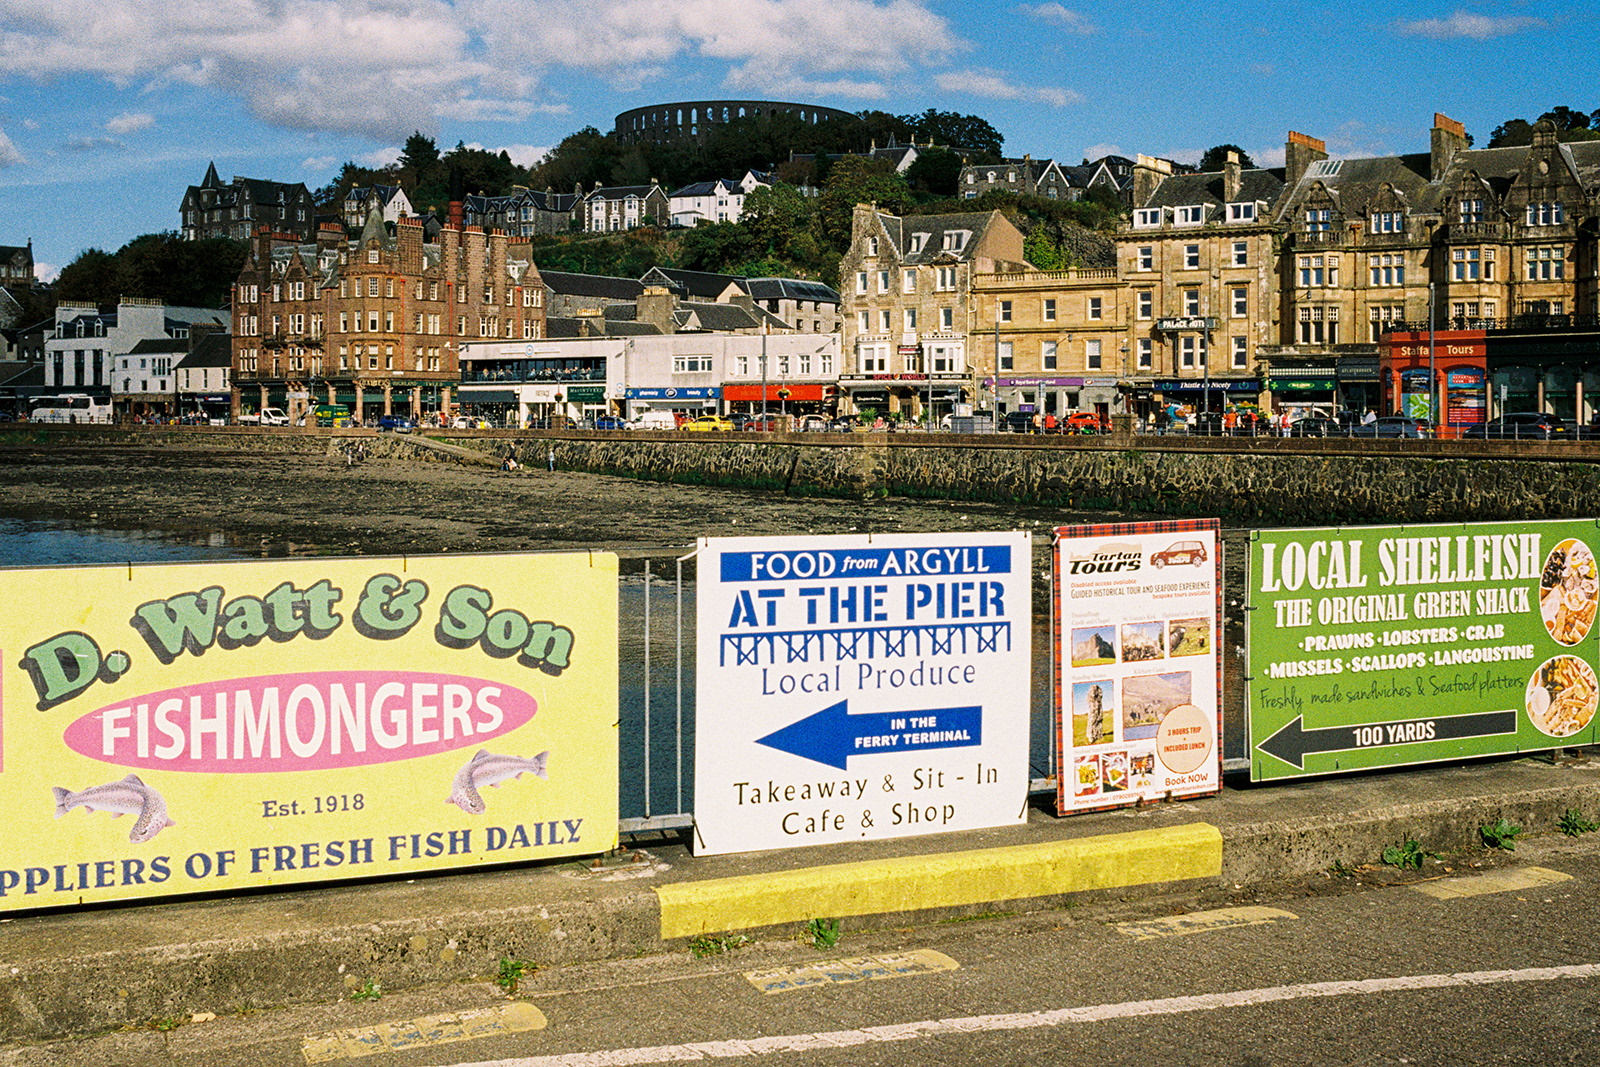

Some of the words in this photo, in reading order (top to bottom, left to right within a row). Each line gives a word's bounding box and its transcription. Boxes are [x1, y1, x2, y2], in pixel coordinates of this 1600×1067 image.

[1401, 346, 1429, 356] Staffa
[1446, 344, 1474, 354] Tours
[1211, 382, 1232, 390] Nicely
[750, 550, 836, 579] FOOD
[841, 556, 878, 573] from
[881, 548, 990, 576] ARGYLL
[1069, 560, 1142, 575] Tours
[1092, 551, 1142, 562] Tartan
[1261, 540, 1368, 592] LOCAL
[1378, 534, 1542, 588] SHELLFISH
[1094, 587, 1124, 598] HISTORICAL
[1126, 586, 1140, 596] TOUR
[1142, 584, 1154, 594] AND
[1154, 583, 1178, 593] SEAFOOD
[1179, 580, 1210, 590] EXPERIENCE
[728, 588, 786, 628] AT
[798, 584, 888, 624] THE
[906, 580, 1005, 620] PIER
[1274, 599, 1312, 628] THE
[1318, 594, 1408, 625] ORIGINAL
[1414, 590, 1471, 618] GREEN
[1476, 587, 1530, 615] SHACK
[18, 631, 132, 712] D.
[130, 577, 344, 666] Watt
[352, 573, 430, 640] &
[434, 584, 574, 676] Son
[762, 664, 840, 696] Local
[858, 660, 976, 690] Produce
[1260, 686, 1302, 715] Freshly
[1310, 685, 1342, 706] made
[1346, 679, 1412, 702] sandwiches
[1417, 678, 1426, 696] &
[1428, 673, 1478, 696] Seafood
[1479, 674, 1524, 699] platters
[101, 682, 504, 761] FISHMONGERS
[890, 718, 906, 730] IN
[910, 716, 936, 729] THE
[1172, 727, 1190, 736] HOURS
[1353, 726, 1382, 746] 100
[1386, 722, 1436, 744] YARDS
[855, 734, 899, 748] FERRY
[903, 730, 970, 746] TERMINAL
[1164, 744, 1188, 752] INCLUDED
[1189, 742, 1206, 750] LUNCH
[733, 777, 868, 806] Takeaway
[882, 774, 896, 793] &
[912, 766, 945, 791] Sit
[976, 763, 998, 785] In
[1165, 776, 1186, 786] Book
[1188, 773, 1208, 783] NOW
[262, 799, 306, 818] Est.
[313, 793, 366, 815] 1918
[782, 810, 846, 836] Cafe
[860, 808, 874, 829] &
[892, 802, 956, 826] Shop
[185, 850, 236, 879] OF
[250, 837, 374, 874] FRESH
[388, 830, 472, 862] FISH
[486, 818, 584, 853] DAILY
